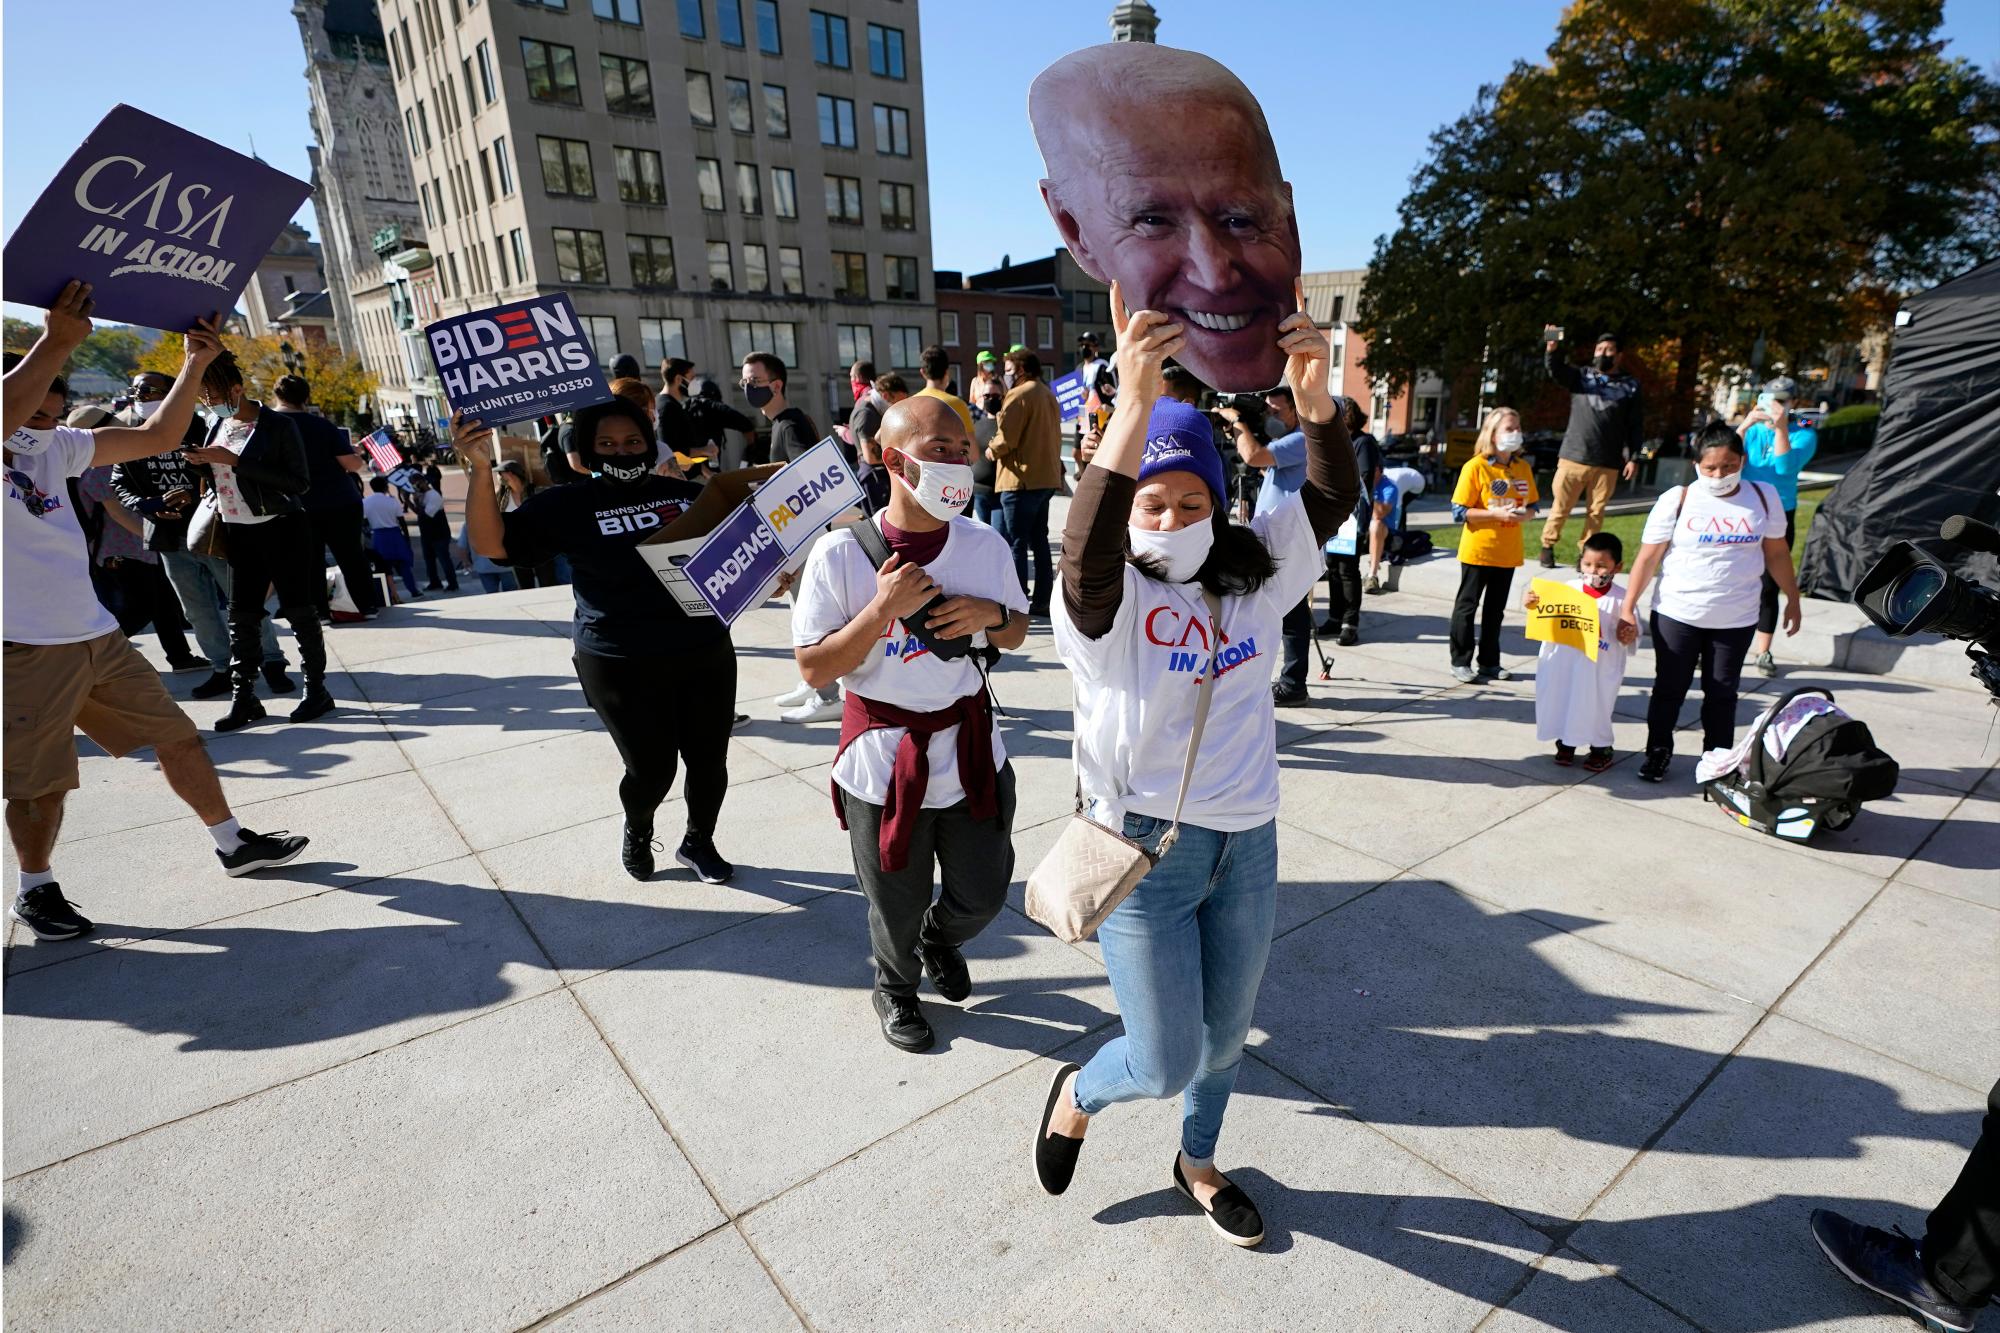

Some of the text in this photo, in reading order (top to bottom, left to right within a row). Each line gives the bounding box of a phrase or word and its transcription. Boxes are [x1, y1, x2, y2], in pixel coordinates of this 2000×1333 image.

[74, 155, 235, 249] CASA
[78, 224, 237, 285] IN ACTION
[430, 302, 577, 368] BIDEN
[442, 341, 591, 399] HARRIS
[480, 390, 535, 411] UNITED
[537, 390, 549, 399] to
[549, 377, 593, 395] 30330
[1142, 434, 1182, 459] ASA
[602, 462, 647, 480] BIDEN
[595, 498, 681, 519] PENNSYLVANIA
[768, 465, 845, 533] PADEMS
[940, 496, 950, 505] IN
[1687, 516, 1755, 534] CASA
[1698, 534, 1762, 544] IN ACTION
[703, 523, 774, 601] PADEMS
[1536, 604, 1583, 615] VOTERS
[1560, 619, 1594, 633] DECIDE
[1168, 652, 1198, 672] IN
